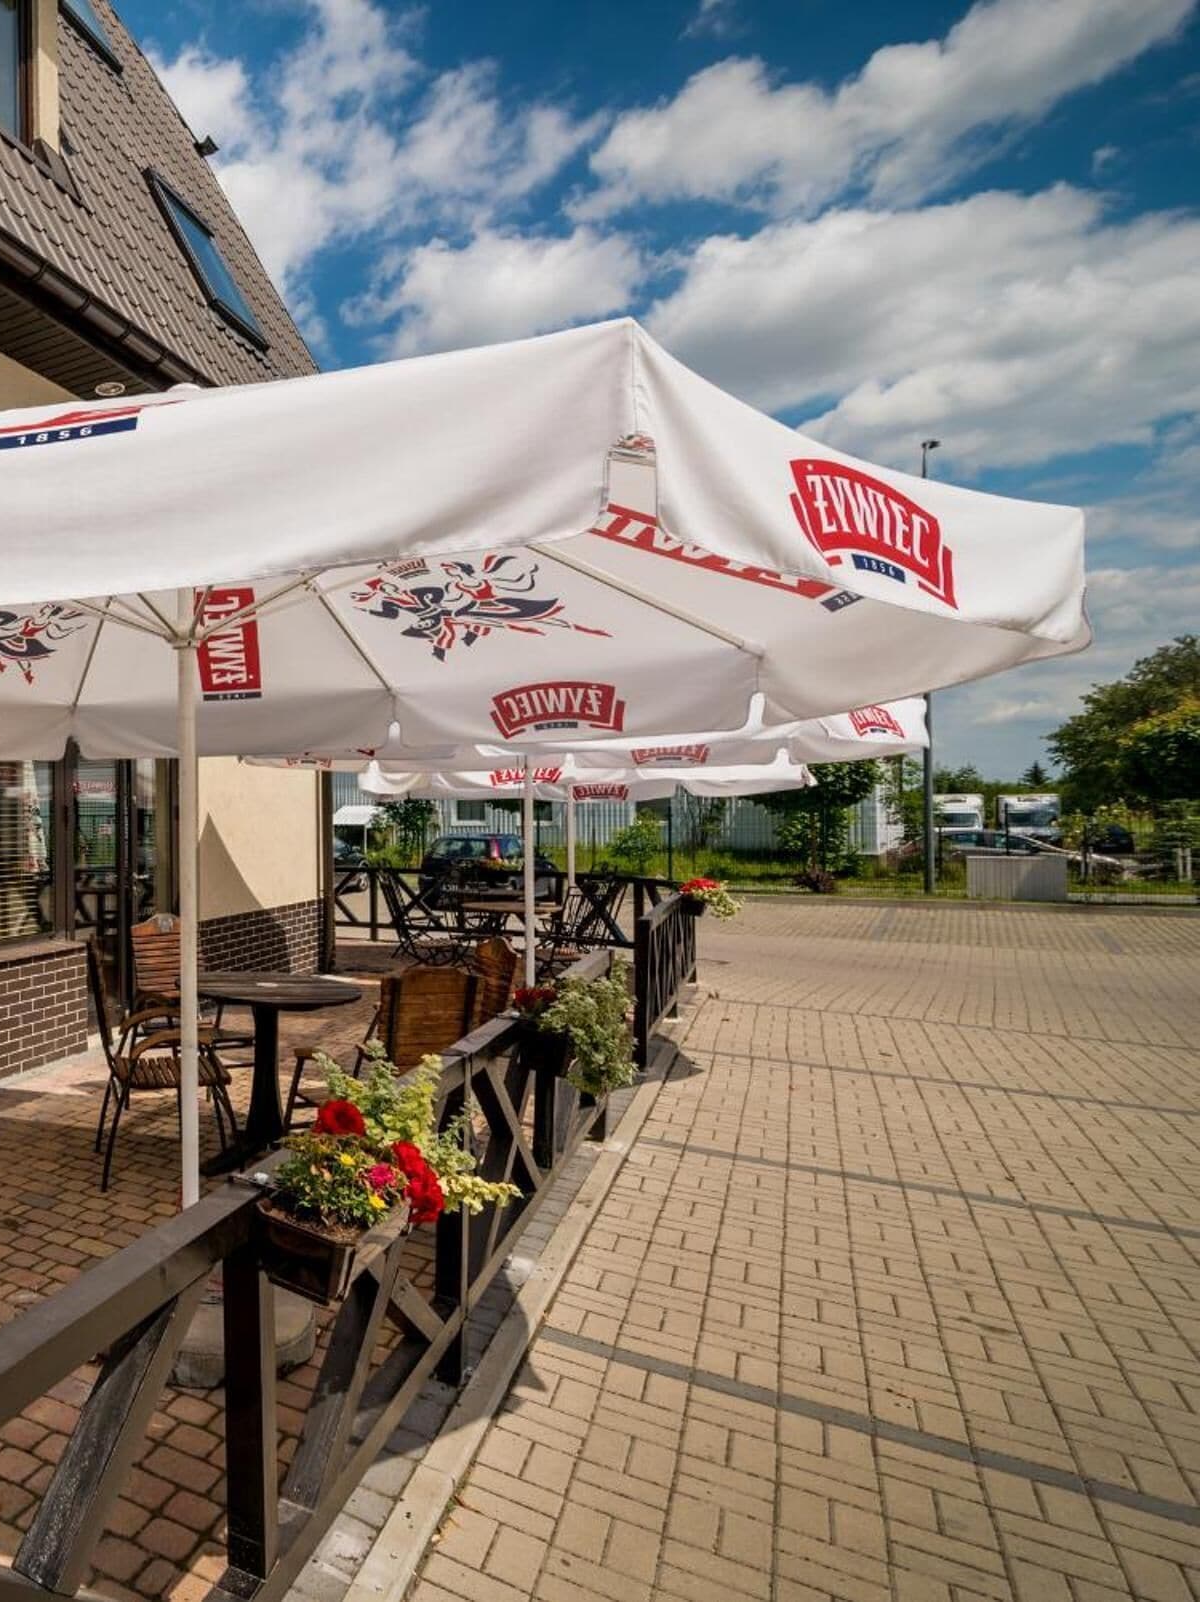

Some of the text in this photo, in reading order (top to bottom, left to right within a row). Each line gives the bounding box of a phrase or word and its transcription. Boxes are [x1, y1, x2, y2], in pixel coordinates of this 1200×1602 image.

[16, 427, 93, 446] 1856
[804, 463, 931, 569] ŻYWIEC
[863, 557, 896, 577] 1856
